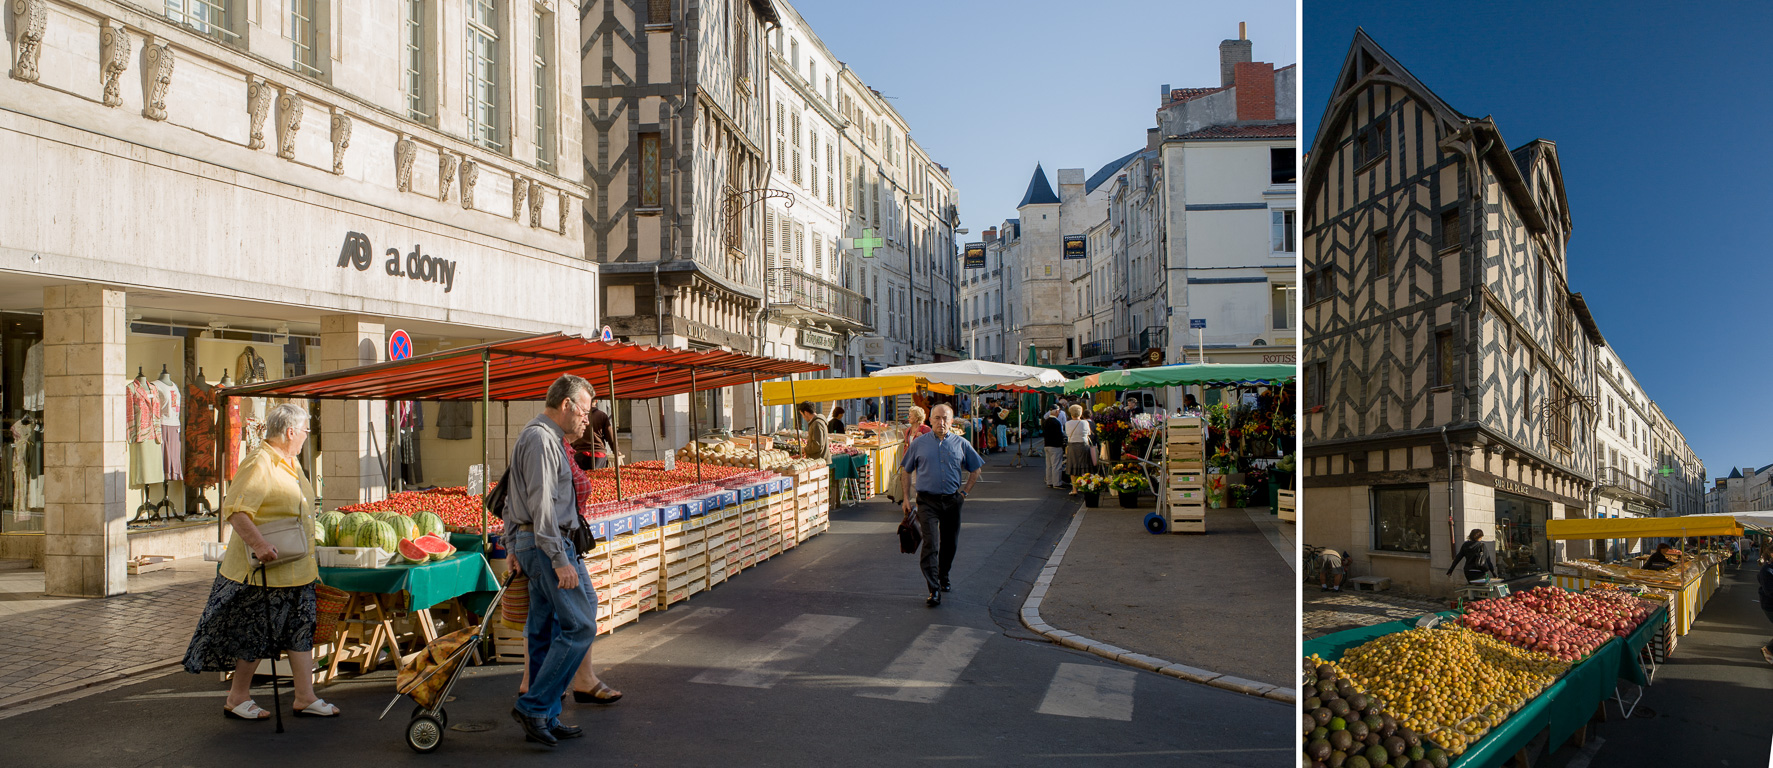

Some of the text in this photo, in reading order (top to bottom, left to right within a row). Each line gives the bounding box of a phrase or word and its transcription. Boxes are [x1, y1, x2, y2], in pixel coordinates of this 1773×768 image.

[385, 244, 457, 293] a.dony
[1494, 478, 1529, 495] SUR LA PLACE
